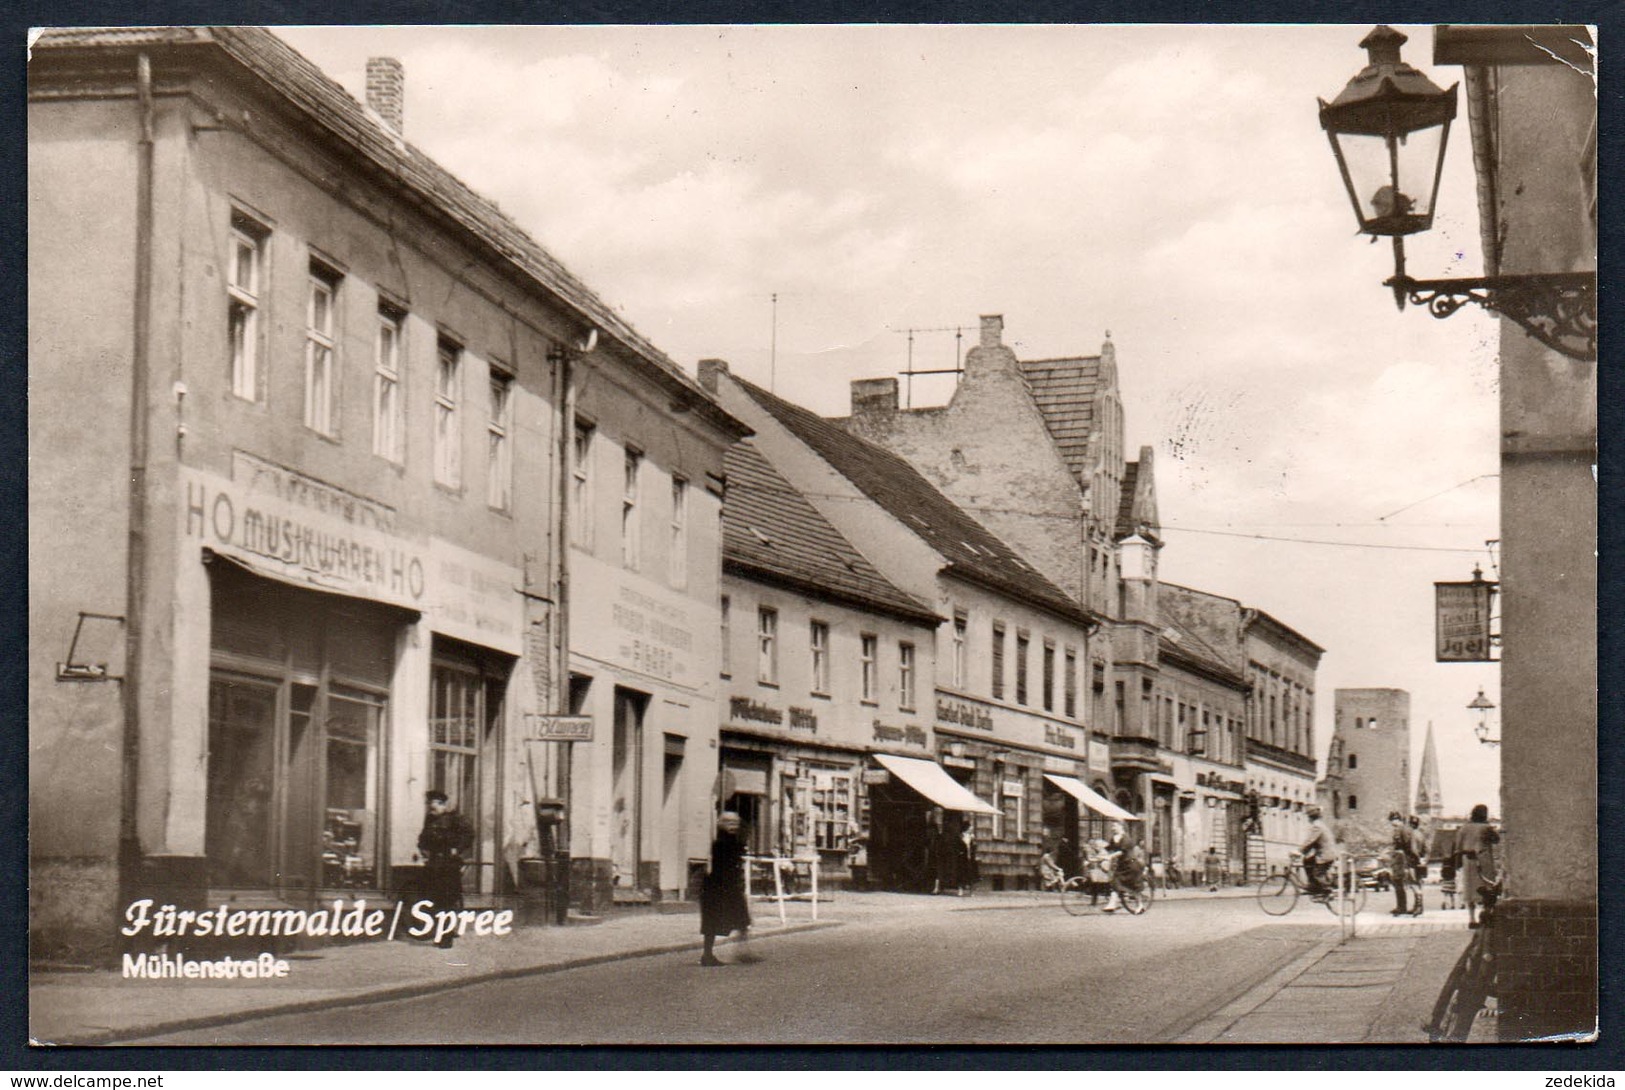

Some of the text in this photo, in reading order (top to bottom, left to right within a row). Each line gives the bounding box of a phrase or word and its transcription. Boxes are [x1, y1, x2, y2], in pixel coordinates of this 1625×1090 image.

[187, 480, 235, 545] HO
[244, 508, 386, 584] MUSIKWAREN
[391, 551, 425, 600] HO
